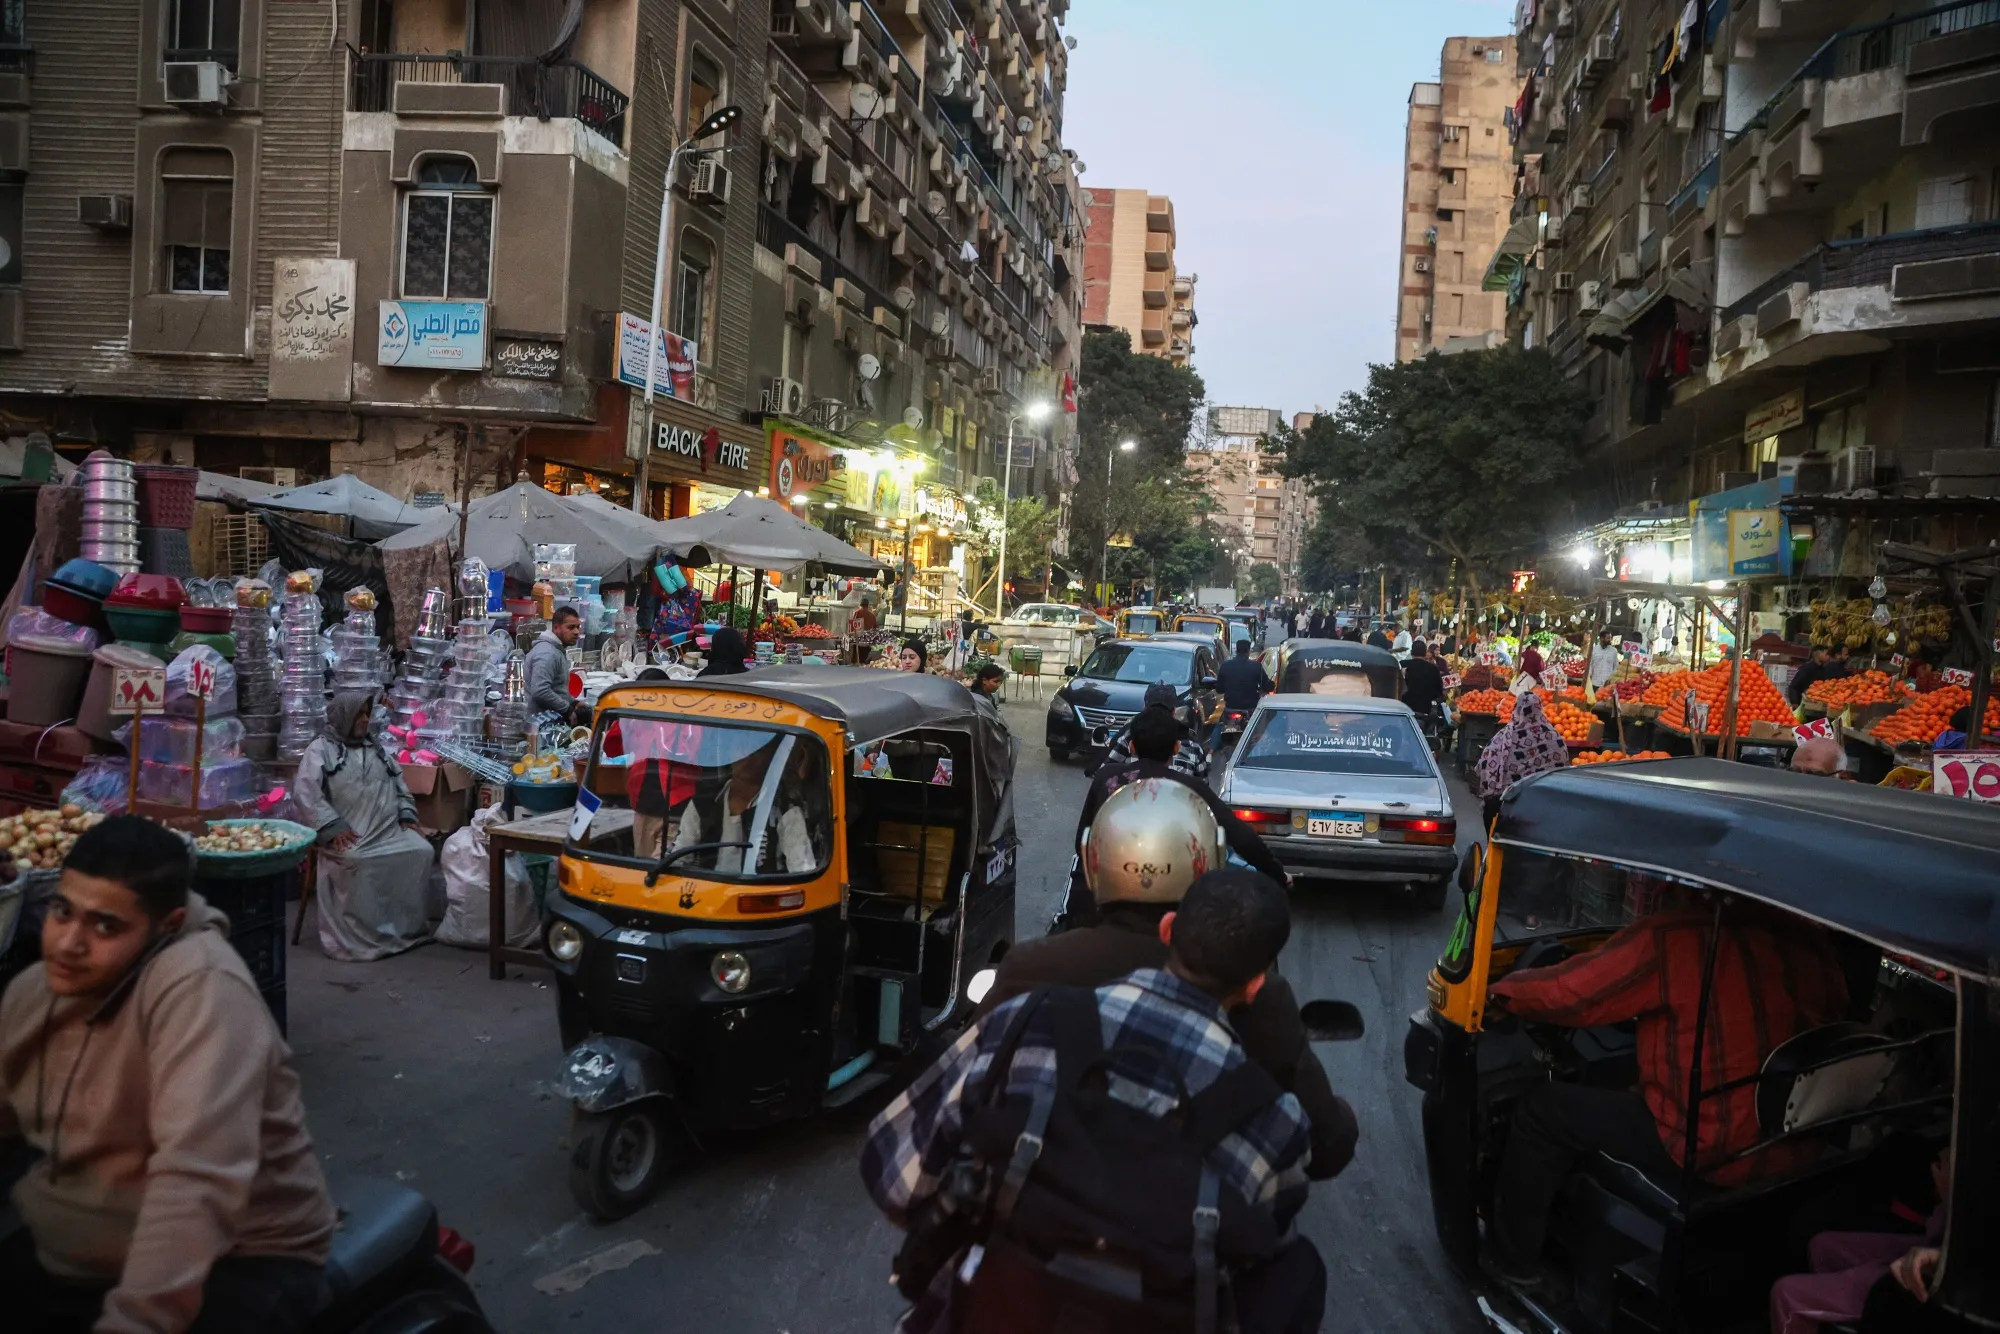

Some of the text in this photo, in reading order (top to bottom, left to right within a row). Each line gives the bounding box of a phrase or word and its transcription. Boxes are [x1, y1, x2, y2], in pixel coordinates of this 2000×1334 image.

[412, 313, 480, 346] مصر الطبي
[657, 423, 701, 459] BACK
[719, 442, 751, 470] FIRE
[120, 680, 155, 704] ١٨
[1287, 732, 1300, 745] الله
[1301, 733, 1322, 748] رسول
[1323, 735, 1344, 746] محمد
[1346, 733, 1359, 747] الله
[1386, 737, 1393, 749] لا
[1311, 820, 1332, 833] ٤٦٧
